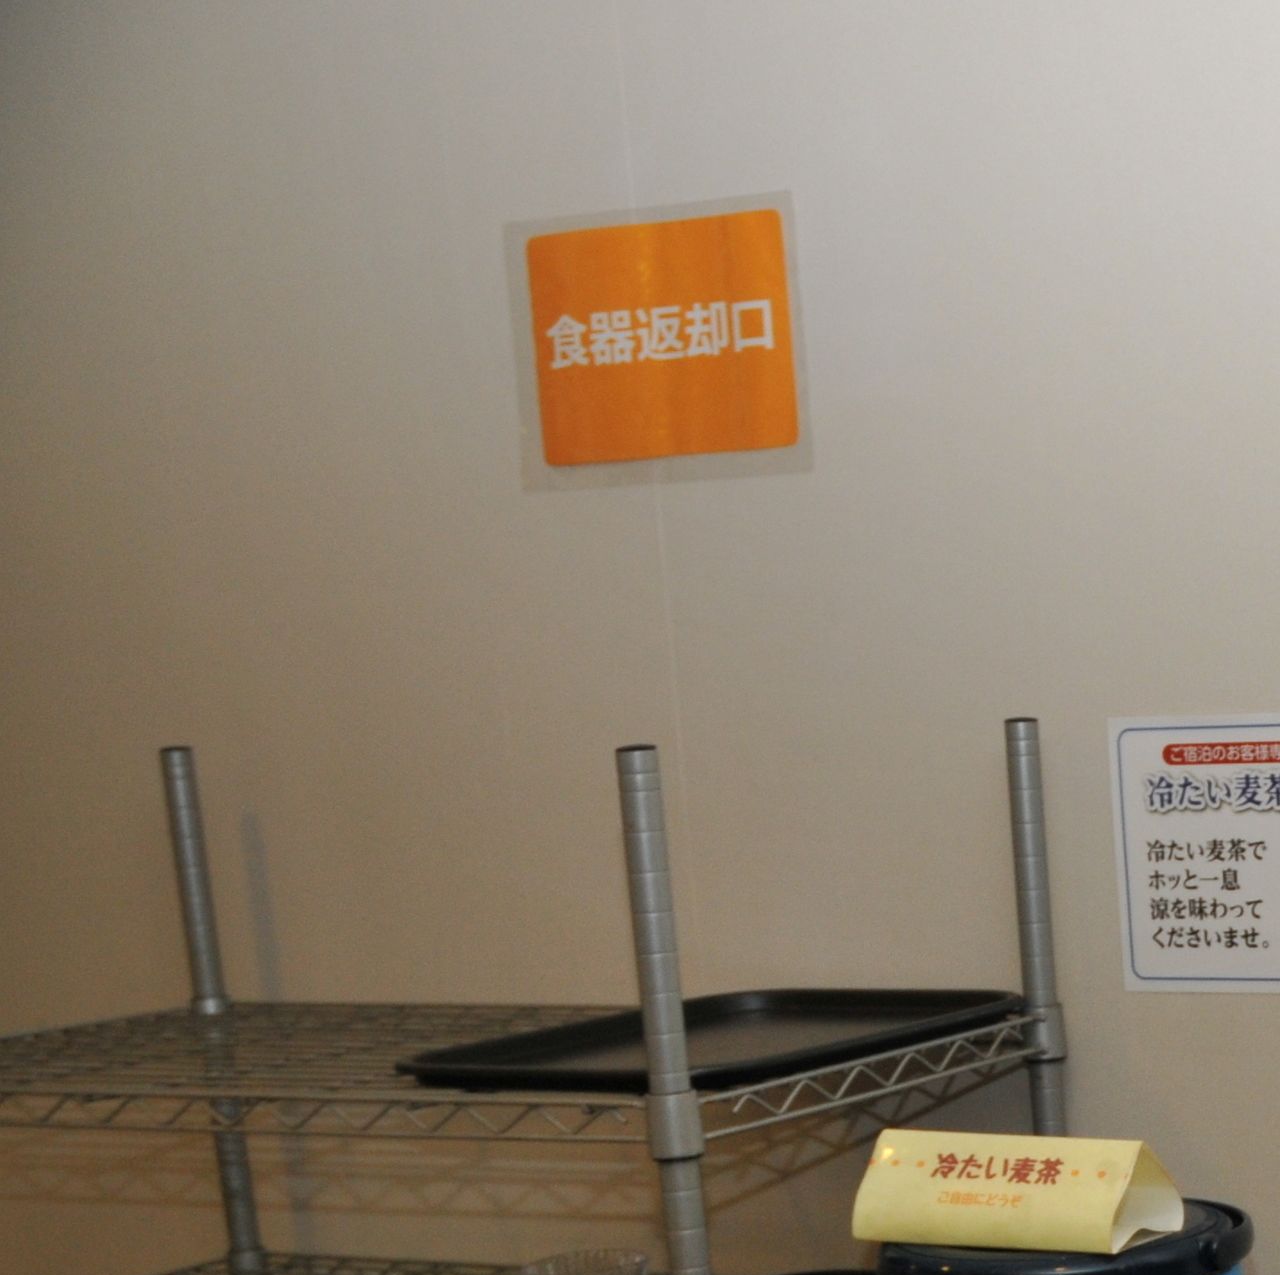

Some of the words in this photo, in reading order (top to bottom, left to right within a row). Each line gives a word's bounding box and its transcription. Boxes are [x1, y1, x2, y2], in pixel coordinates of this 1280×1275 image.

[546, 298, 776, 370] 食器返却口
[1146, 839, 1268, 862] 冷たい麦茶で
[1148, 868, 1241, 891] ホッと一息
[1149, 897, 1264, 921] 涼を味わって
[1151, 927, 1271, 949] くださいませ。
[930, 1152, 1065, 1185] 冷たい麦茶
